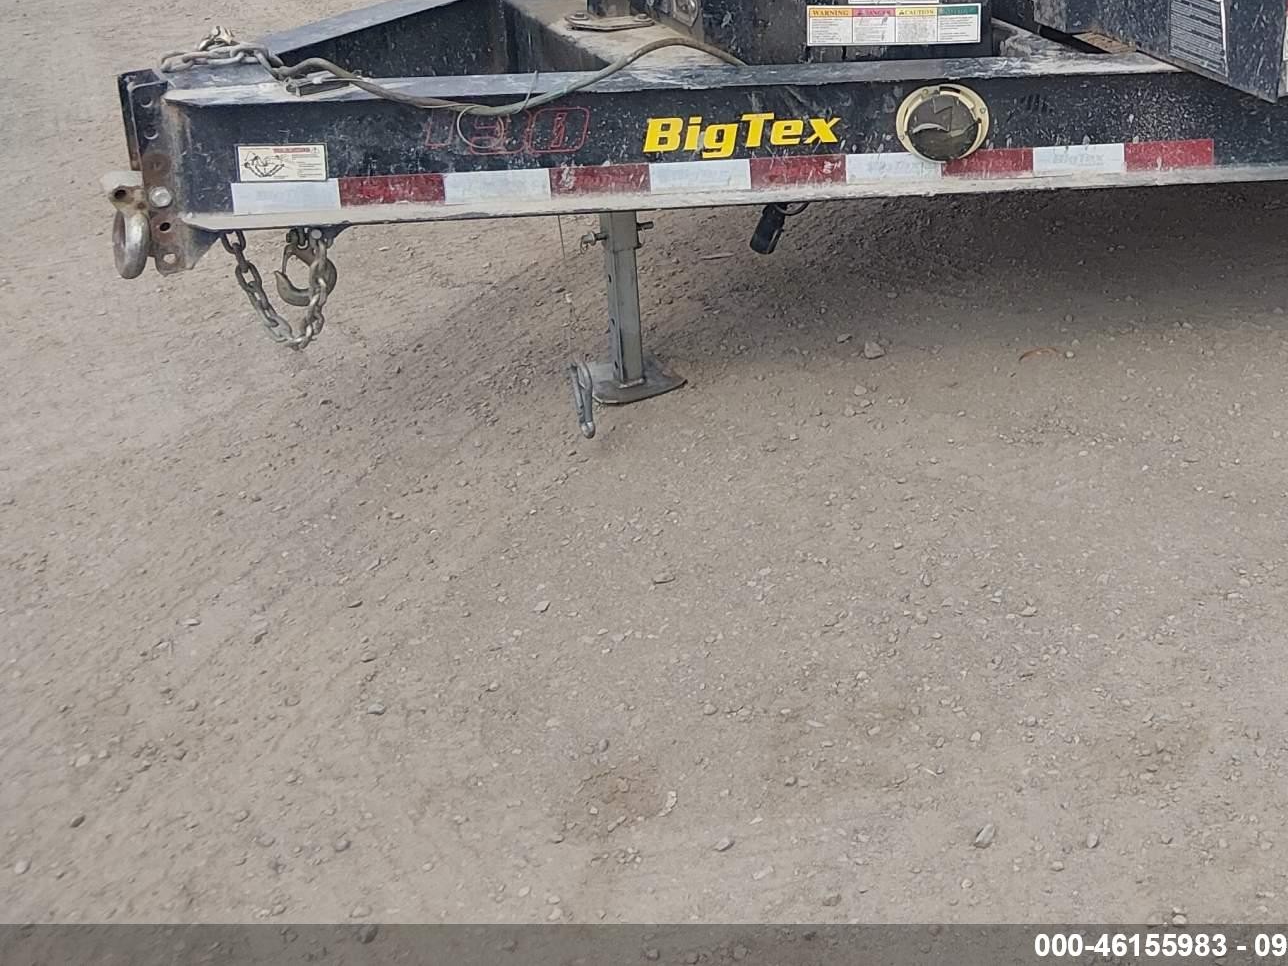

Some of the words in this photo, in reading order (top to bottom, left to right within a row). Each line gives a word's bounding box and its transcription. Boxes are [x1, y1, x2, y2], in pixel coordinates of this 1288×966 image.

[812, 8, 850, 17] WARNING
[904, 8, 935, 16] CAUTION
[642, 112, 842, 160] BigTex
